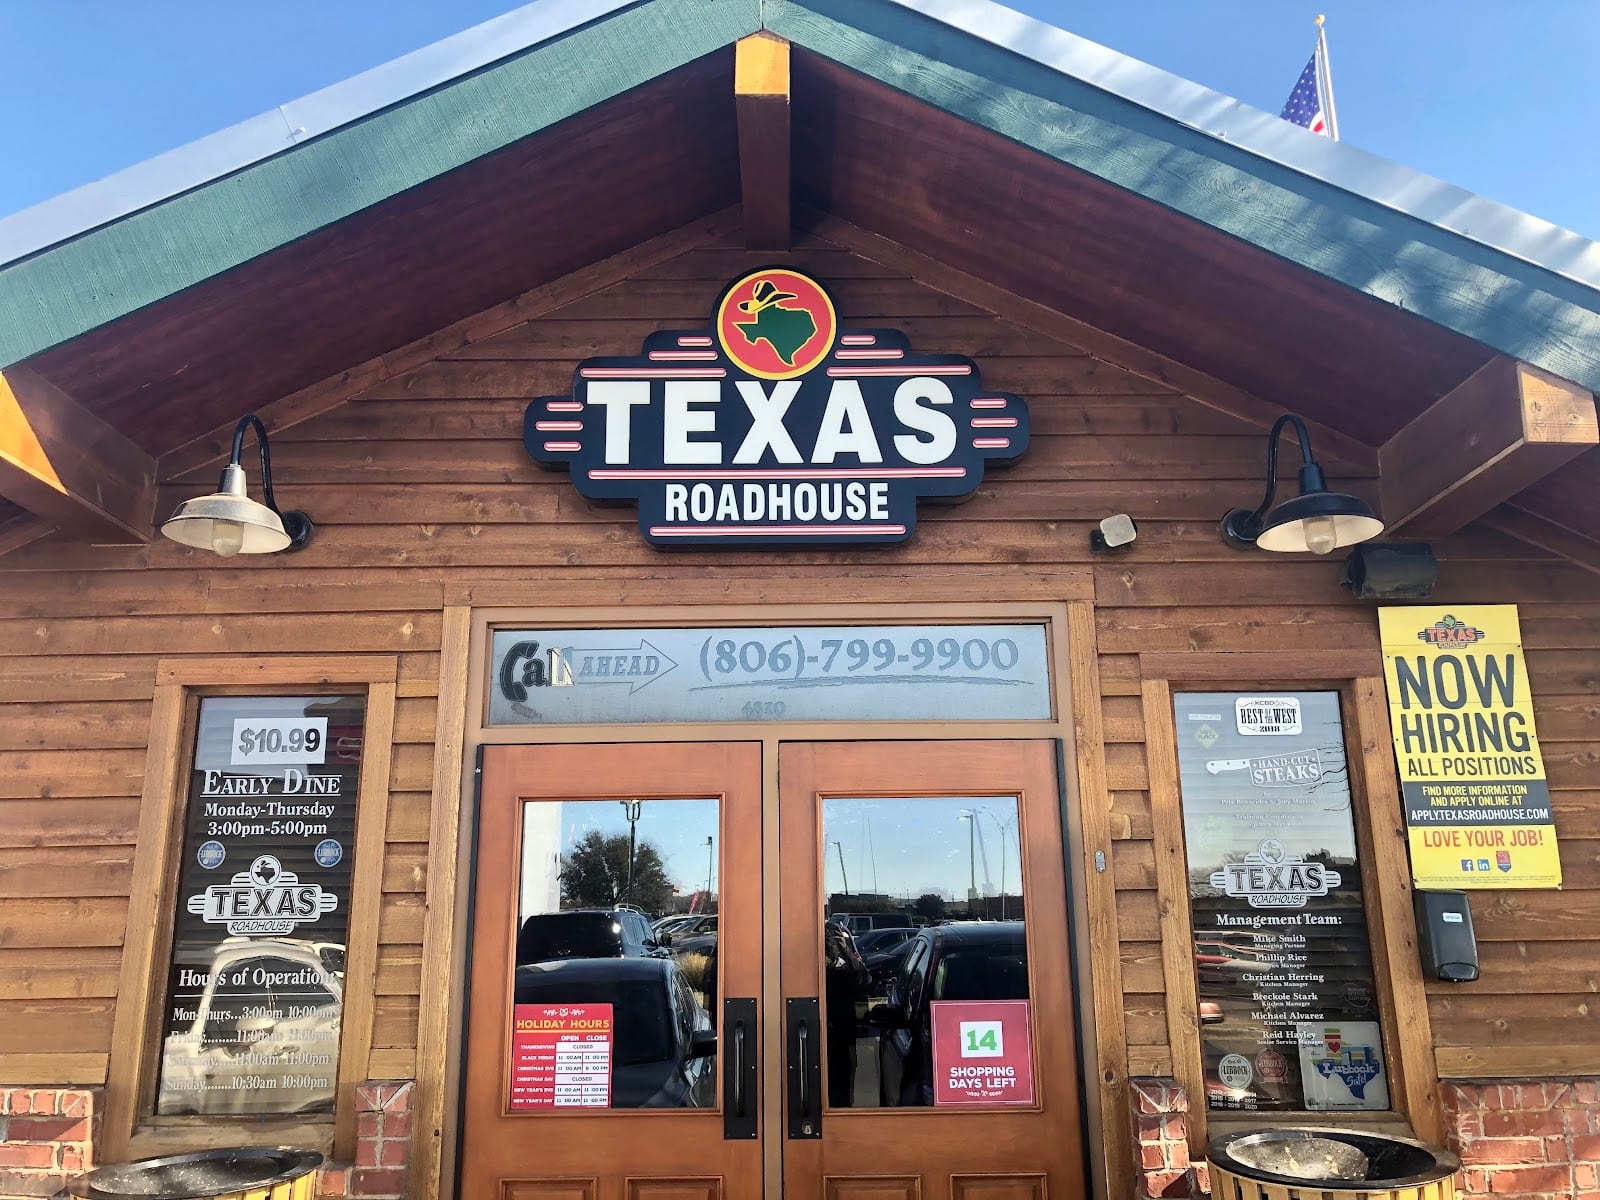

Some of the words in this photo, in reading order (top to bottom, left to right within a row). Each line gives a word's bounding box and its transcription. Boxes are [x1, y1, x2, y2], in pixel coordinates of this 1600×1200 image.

[586, 377, 957, 465] TEXAS
[665, 483, 889, 522] ROADHOUSE
[1427, 628, 1477, 642] TEXAS
[579, 655, 660, 677] AHEAD
[699, 634, 1019, 682] (806)-799-9900
[1394, 653, 1515, 710] NOW
[1240, 708, 1263, 724] BEST
[1273, 708, 1297, 724] WEST
[1259, 725, 1280, 733] 2018
[1400, 711, 1532, 754] HIRING
[238, 727, 321, 757] $10.99
[1253, 762, 1319, 784] STEAKS
[1407, 758, 1439, 777] ALL
[1442, 756, 1537, 776] POSITIONS
[202, 769, 274, 795] EARLY
[281, 768, 341, 794] DINE
[1422, 786, 1442, 796] FIND
[1443, 785, 1467, 796] MORE
[1468, 784, 1528, 795] INFORMATION
[1430, 796, 1448, 807] AND
[1449, 796, 1476, 807] APPLY
[1478, 795, 1510, 806] ONLINE
[1511, 795, 1522, 806] AT
[203, 801, 335, 819] Monday-Thursday
[1411, 808, 1549, 821] APPLY.TEXASROADHOUSE.COM
[207, 820, 328, 838] 3:00pm-5:00pm
[1423, 830, 1462, 848] LOVE
[1463, 830, 1505, 847] YOUR
[1509, 829, 1544, 847] JOB!
[1229, 866, 1323, 891] TEXAS
[211, 887, 318, 917] TEXAS
[1250, 894, 1306, 904] ROADHOUSE
[229, 920, 294, 932] ROADHOUSE
[1215, 913, 1301, 929] Management
[1302, 913, 1342, 925] Team:
[1252, 935, 1276, 943] Mike
[1278, 934, 1307, 942] Smith
[1255, 953, 1286, 963] Phillip
[1287, 953, 1308, 961] Rice
[231, 967, 250, 986] of
[1242, 973, 1286, 981] Christian
[1287, 973, 1325, 983] Herring
[1252, 992, 1291, 1001] Breckole
[1293, 992, 1319, 1000] Stark
[516, 1019, 566, 1029] HOLIDAY
[570, 1019, 610, 1029] HOURS
[1251, 1012, 1287, 1020] Michael
[1289, 1012, 1325, 1020] Alvarez
[966, 1029, 998, 1051] 14
[1262, 1030, 1284, 1039] Reid
[1285, 1030, 1317, 1041] Hayley
[950, 1066, 1015, 1077] SHOPPING
[1322, 1062, 1376, 1075] Lubbock
[281, 1074, 328, 1090] 10:00pm
[949, 1078, 982, 1089] DAYS
[986, 1077, 1017, 1088] LEFT
